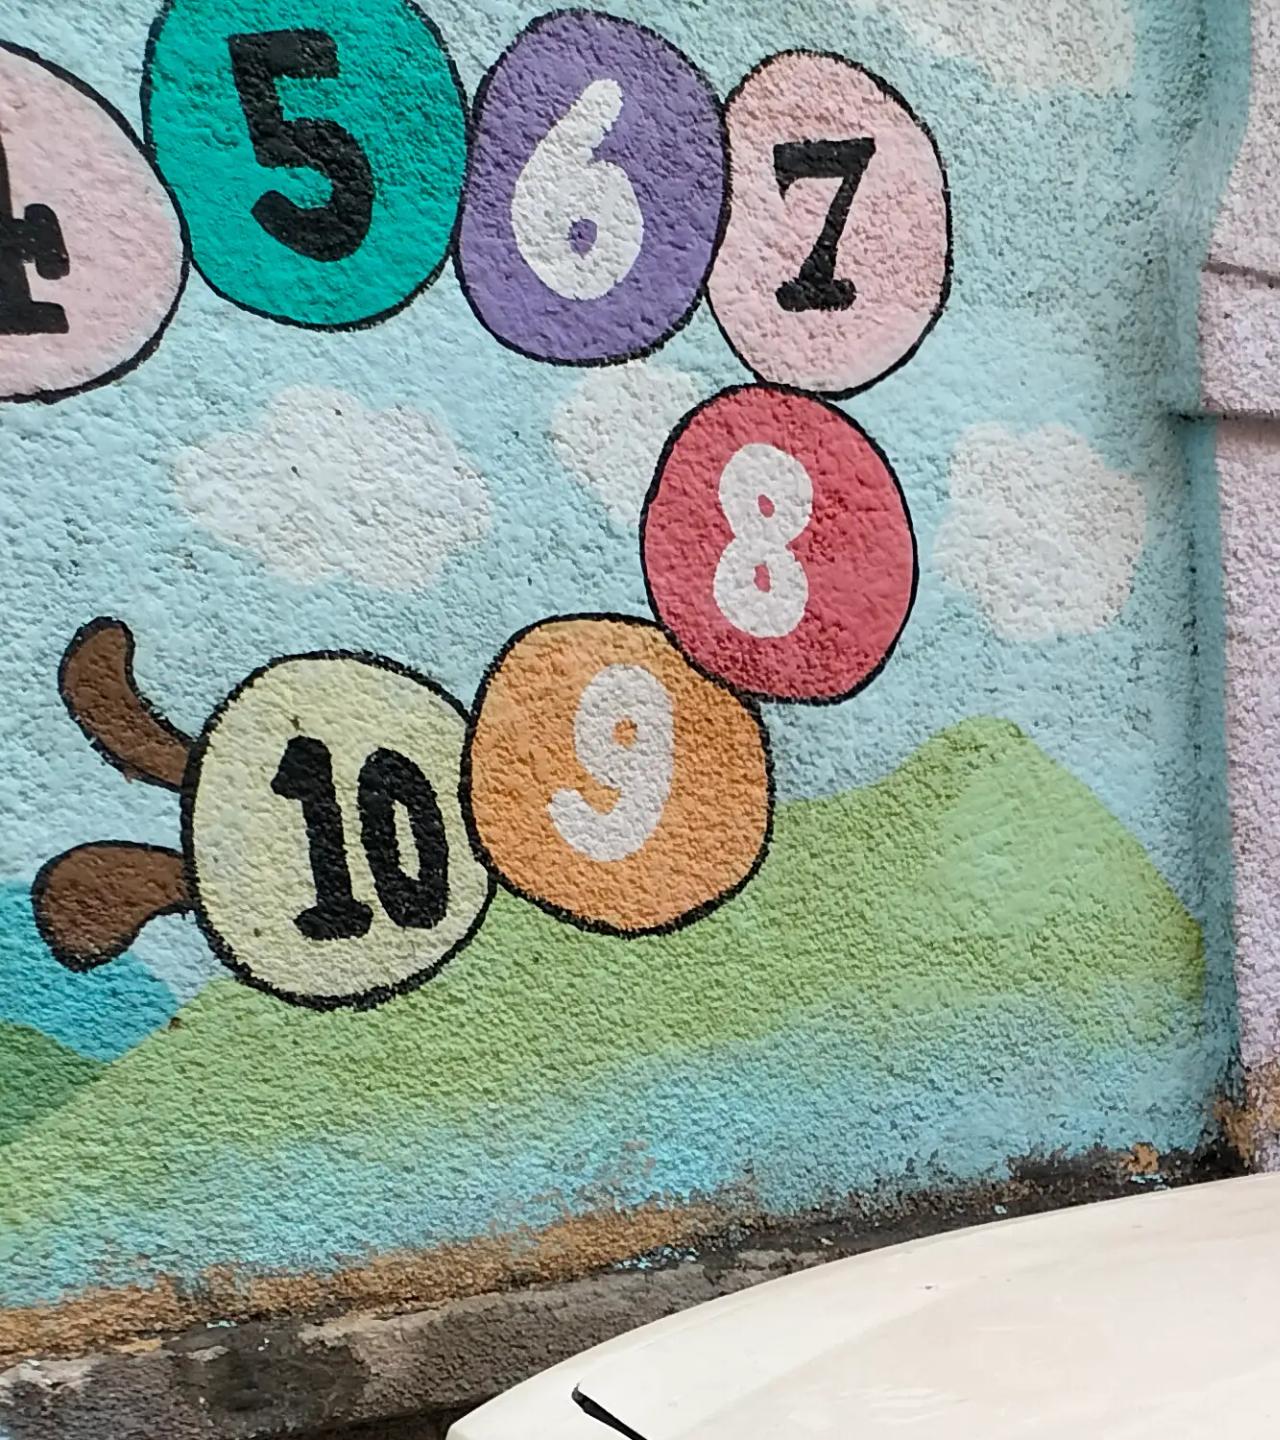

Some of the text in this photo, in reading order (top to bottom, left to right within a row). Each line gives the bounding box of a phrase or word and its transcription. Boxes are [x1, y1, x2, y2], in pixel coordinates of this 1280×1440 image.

[229, 28, 375, 262] 5
[511, 78, 645, 301] 6
[772, 138, 875, 311] 7
[712, 442, 814, 639] 8
[269, 735, 450, 940] 10
[547, 663, 675, 862] 9
